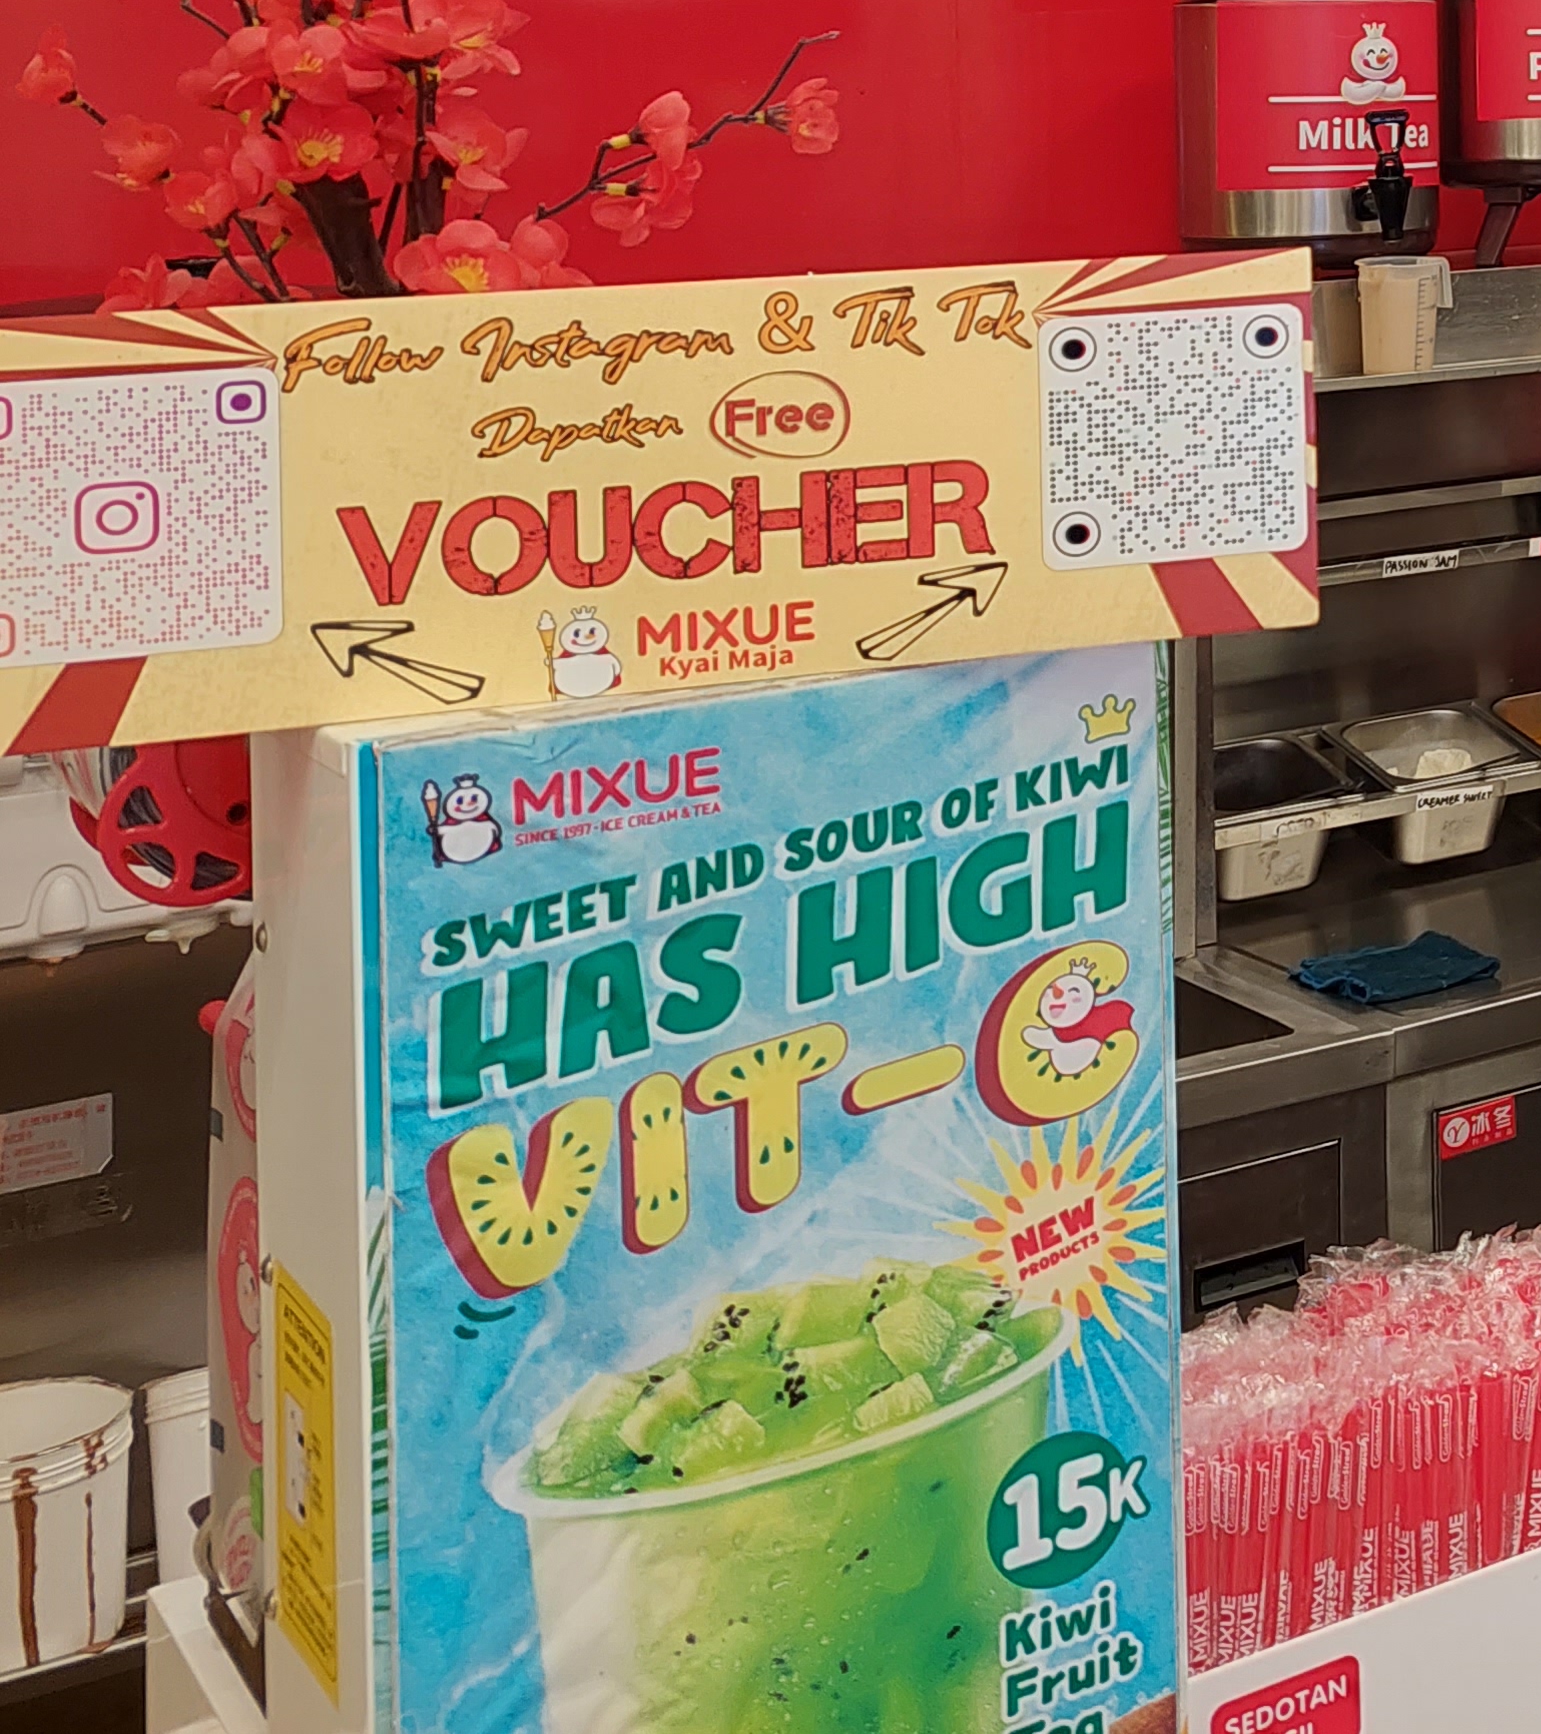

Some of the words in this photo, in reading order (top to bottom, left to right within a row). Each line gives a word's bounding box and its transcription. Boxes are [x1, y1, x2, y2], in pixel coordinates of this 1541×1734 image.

[1298, 116, 1373, 151] Milk
[282, 316, 440, 393] Follow
[462, 318, 733, 385] Instagram
[761, 292, 812, 353] &
[835, 292, 925, 351] Tik
[939, 281, 1032, 343] Tok
[471, 404, 683, 461] Dapatkan
[726, 397, 833, 435] Free
[335, 461, 995, 606] VOUCHER
[1385, 559, 1428, 574] PASSION
[636, 601, 815, 657] MIXUE
[658, 651, 722, 680] Kyai
[728, 641, 793, 673] Maja
[512, 746, 721, 825] MIXUE
[432, 873, 635, 968] SWEET
[658, 842, 764, 912] AND
[784, 800, 922, 871] SOUR
[941, 778, 998, 827] OF
[1015, 744, 1129, 812] KIWI
[438, 915, 741, 1109] HAS
[796, 801, 1129, 1004] HIGH
[426, 942, 1139, 1294] VIT-C
[1011, 1197, 1095, 1263] NEW
[1019, 1232, 1099, 1280] PRODUCTS
[1002, 1452, 1147, 1571] 15K
[1004, 1586, 1112, 1663] Kiwi
[1004, 1638, 1138, 1718] Fruit
[1225, 1674, 1347, 1734] SEDOTAN
